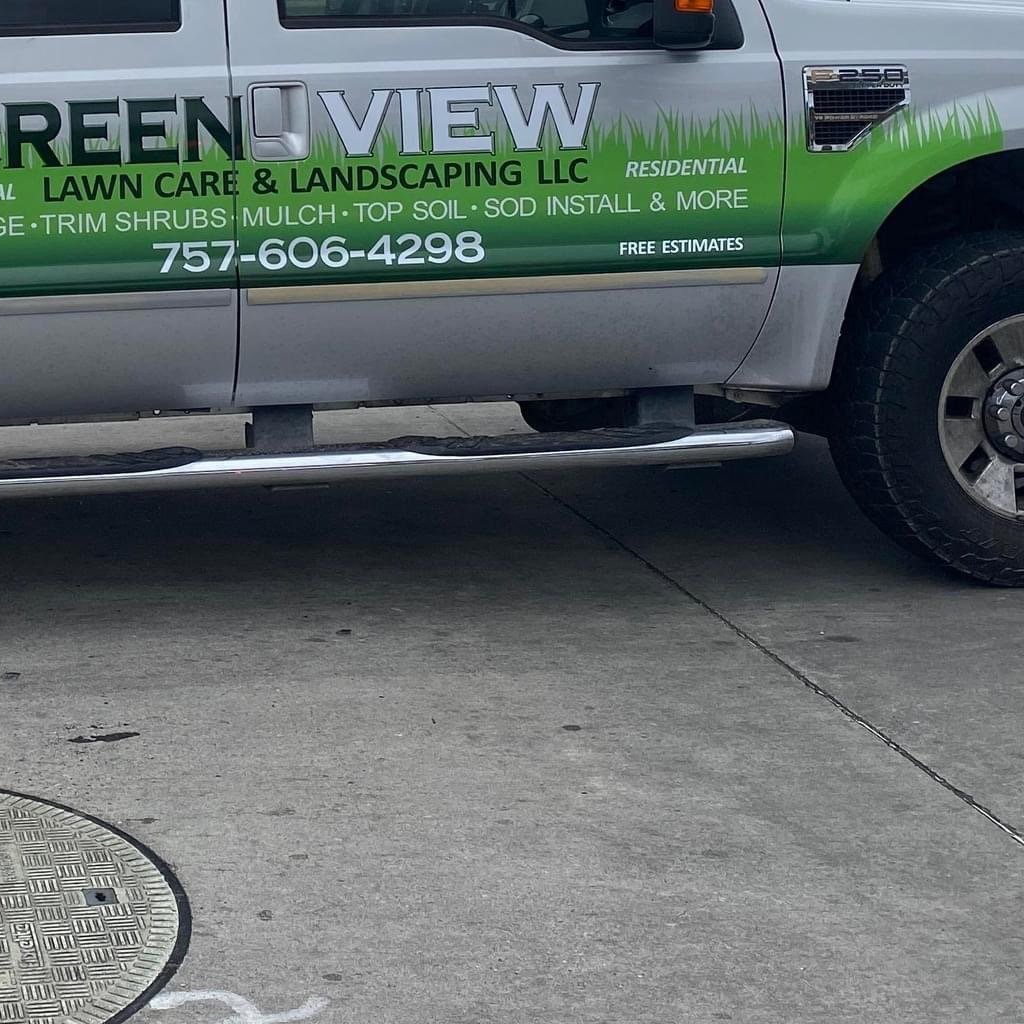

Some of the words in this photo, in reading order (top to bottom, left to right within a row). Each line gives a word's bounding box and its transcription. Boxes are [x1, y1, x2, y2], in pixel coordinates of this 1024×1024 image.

[317, 82, 601, 159] VIEW
[43, 172, 143, 203] LAWN
[154, 169, 240, 198] CARE
[251, 167, 278, 195] &
[290, 159, 522, 194] LANDSCAPING
[537, 157, 589, 185] LLC
[625, 157, 749, 180] RESIDENTIAL
[39, 212, 107, 235] TRIM
[115, 207, 228, 233] SHRUBS
[242, 204, 336, 227] MULCH
[353, 201, 403, 223] TOP
[412, 198, 467, 221] SOIL
[484, 196, 537, 219] SOD
[547, 191, 640, 217] INSTALL
[649, 191, 666, 212] &
[677, 188, 749, 212] MORE
[152, 230, 486, 274] 757-606-4298
[619, 239, 657, 257] FREE
[662, 237, 744, 256] ESTIMATES
